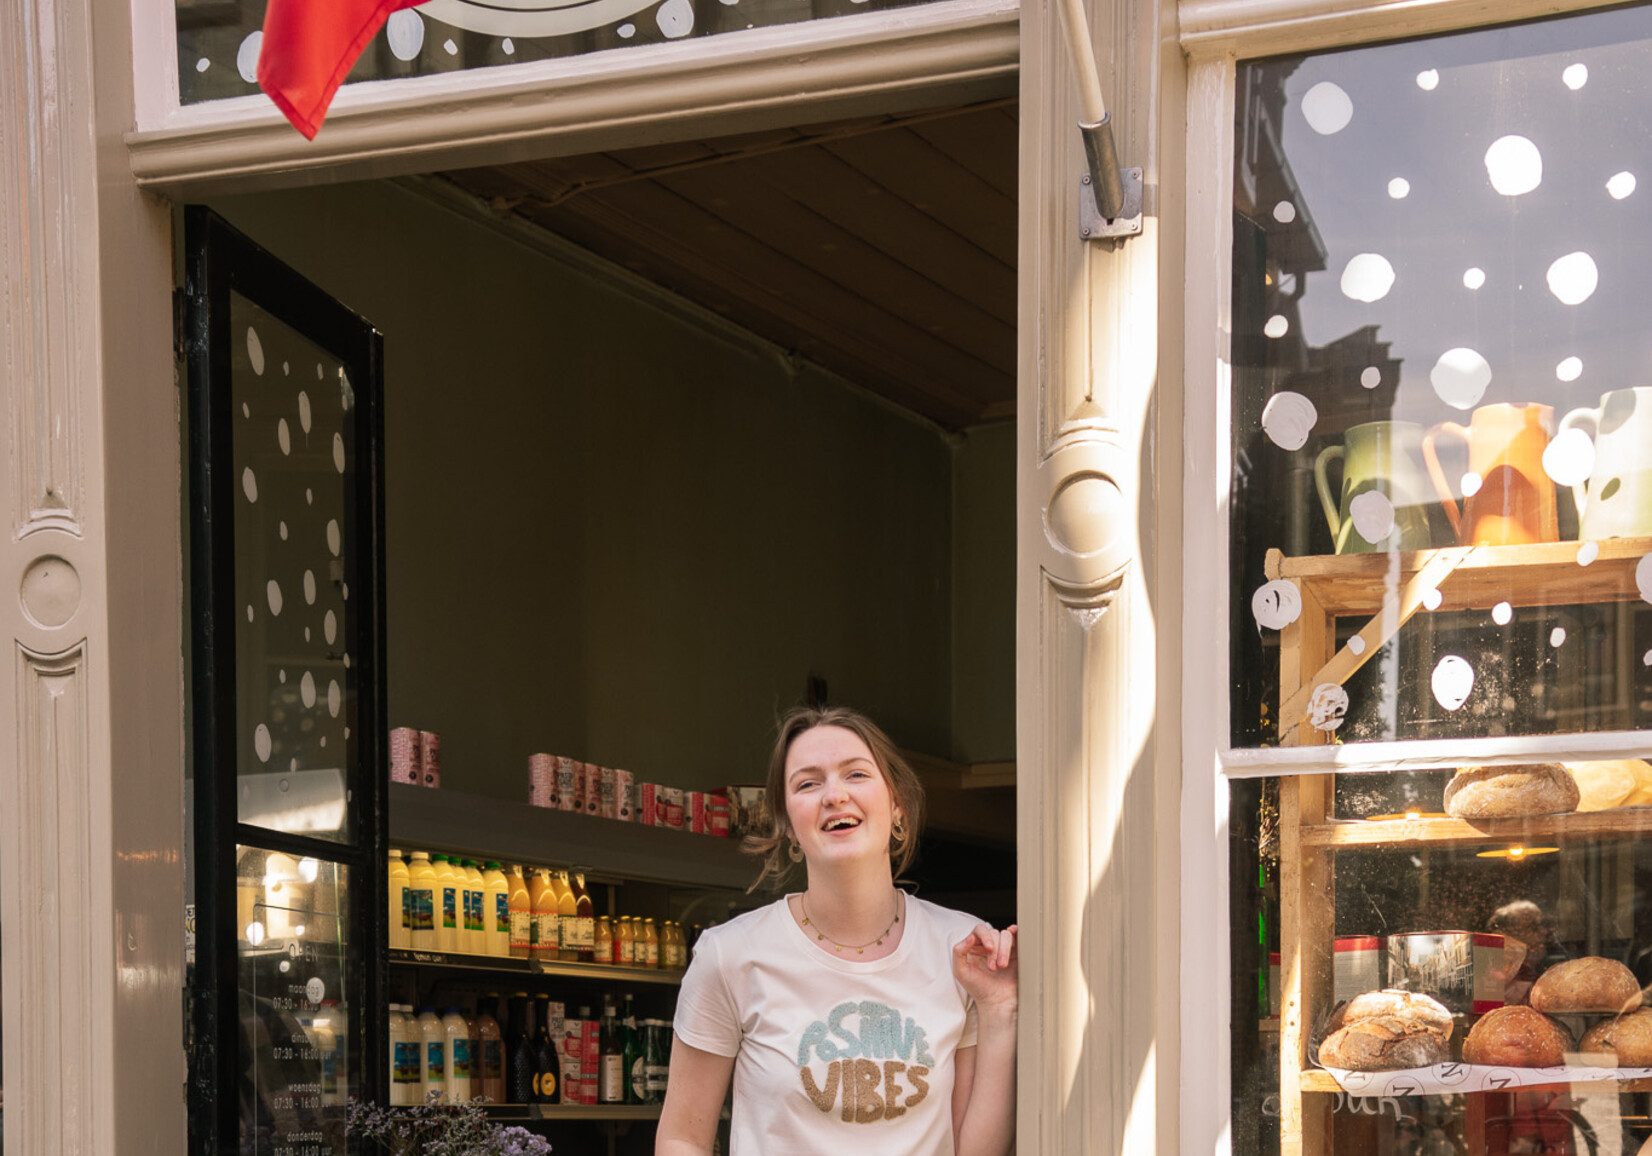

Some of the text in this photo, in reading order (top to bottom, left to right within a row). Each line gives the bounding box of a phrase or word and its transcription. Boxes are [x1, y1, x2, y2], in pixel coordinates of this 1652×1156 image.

[288, 944, 319, 962] OPEN
[272, 998, 292, 1010] 07:30
[273, 1048, 292, 1060] 07:30
[300, 1048, 319, 1060] 16:00
[288, 1082, 321, 1095] woensdag
[799, 1058, 931, 1124] VIBES
[274, 1098, 293, 1109] 07:30
[300, 1097, 319, 1108] 16:00
[286, 1131, 323, 1143] donderdag
[301, 1146, 319, 1156] 16:00
[321, 1146, 333, 1156] uur
